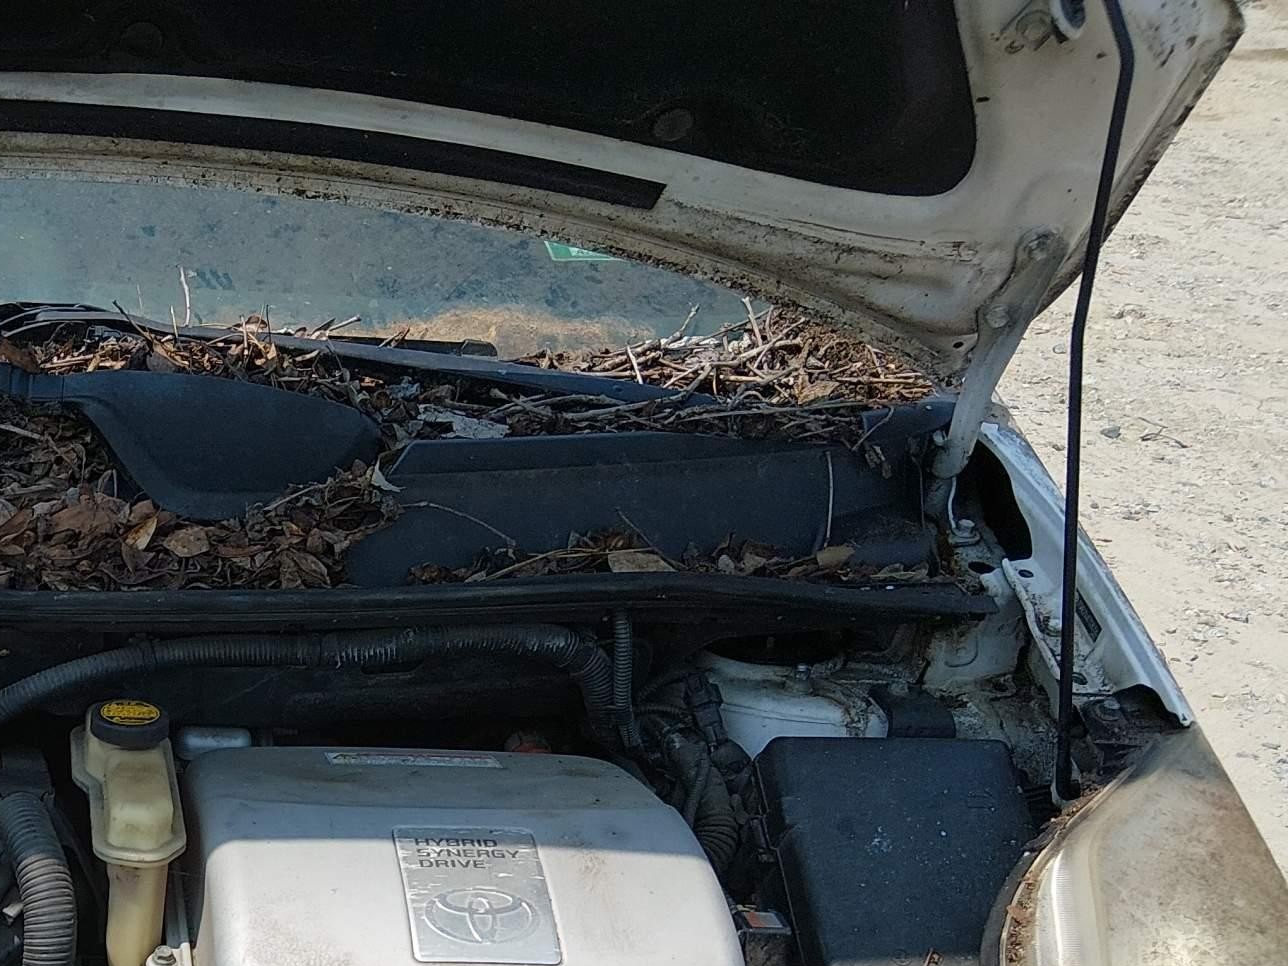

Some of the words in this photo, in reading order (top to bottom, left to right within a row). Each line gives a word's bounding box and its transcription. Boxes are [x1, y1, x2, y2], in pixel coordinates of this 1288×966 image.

[415, 838, 498, 848] HYBRID
[416, 848, 519, 859] SYNERGY
[419, 859, 487, 869] DRIVE
